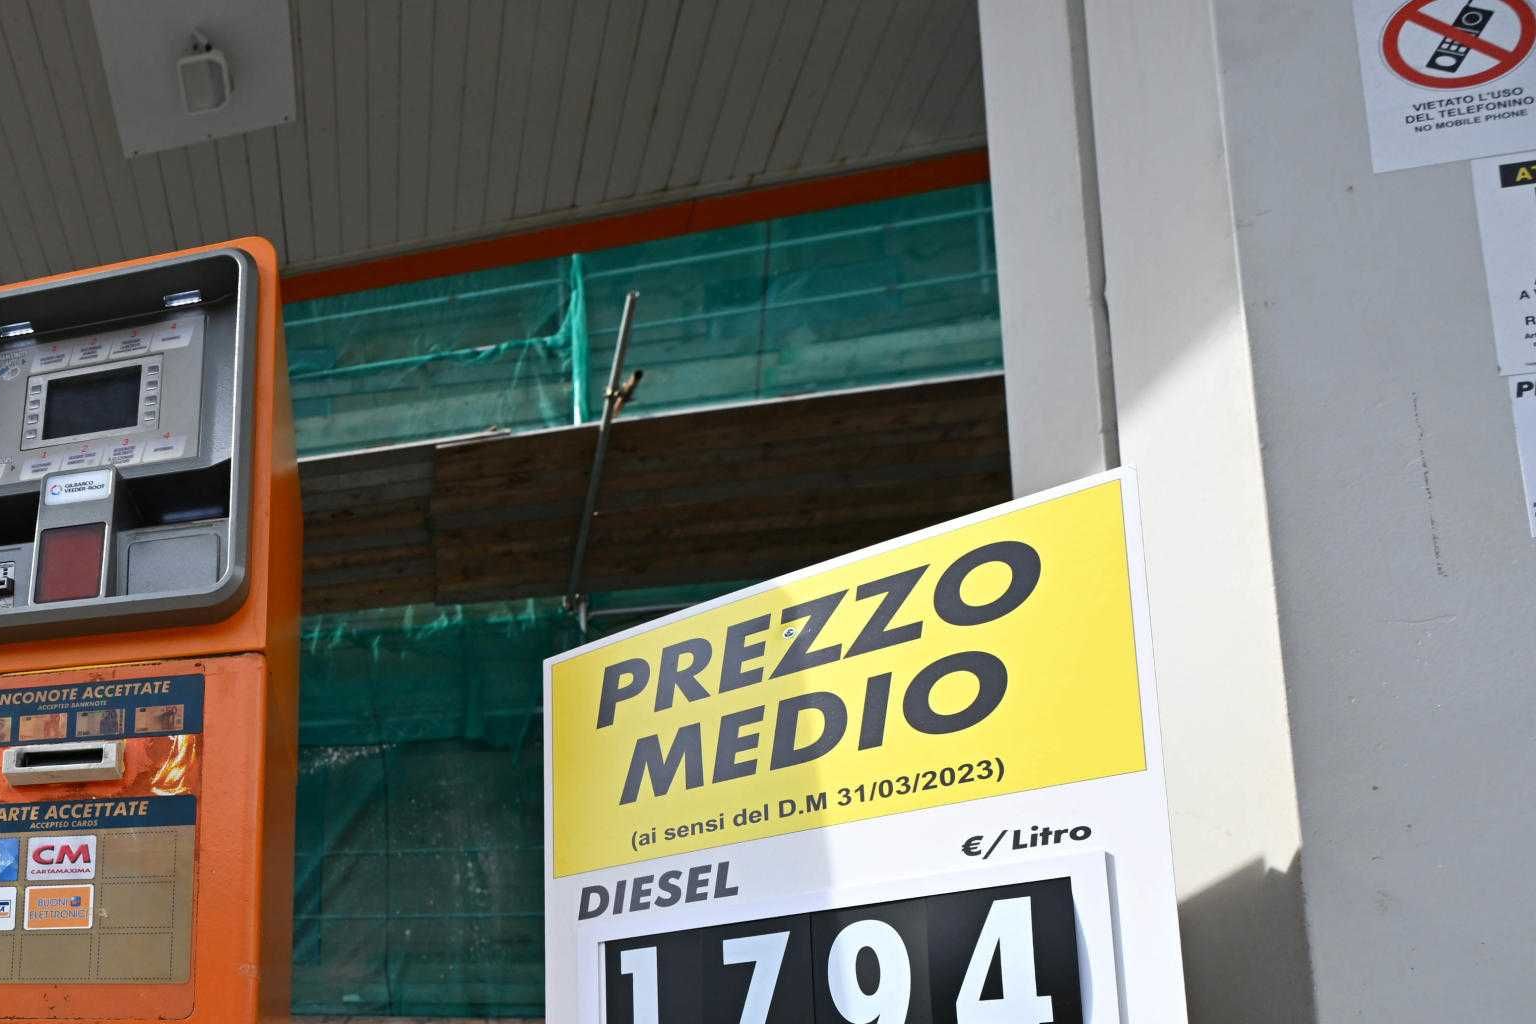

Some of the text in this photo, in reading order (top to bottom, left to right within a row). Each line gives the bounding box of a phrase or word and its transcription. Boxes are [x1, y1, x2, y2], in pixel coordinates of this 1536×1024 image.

[1405, 96, 1535, 124] DEL TELEFONINO
[1412, 87, 1524, 112] VIETATO L'USO
[1414, 109, 1529, 132] NO MOBILE PHONE
[596, 540, 1042, 730] PREZZO
[82, 680, 172, 700] ACCETTATE
[618, 650, 1008, 806] MEDIO
[44, 800, 150, 820] ACCETTATE
[631, 756, 1006, 851] (ai sensi del D.M 31/03/2023)
[29, 820, 98, 830] ACCEPTED CARDS
[32, 844, 92, 866] CM
[578, 861, 739, 921] DIESEL
